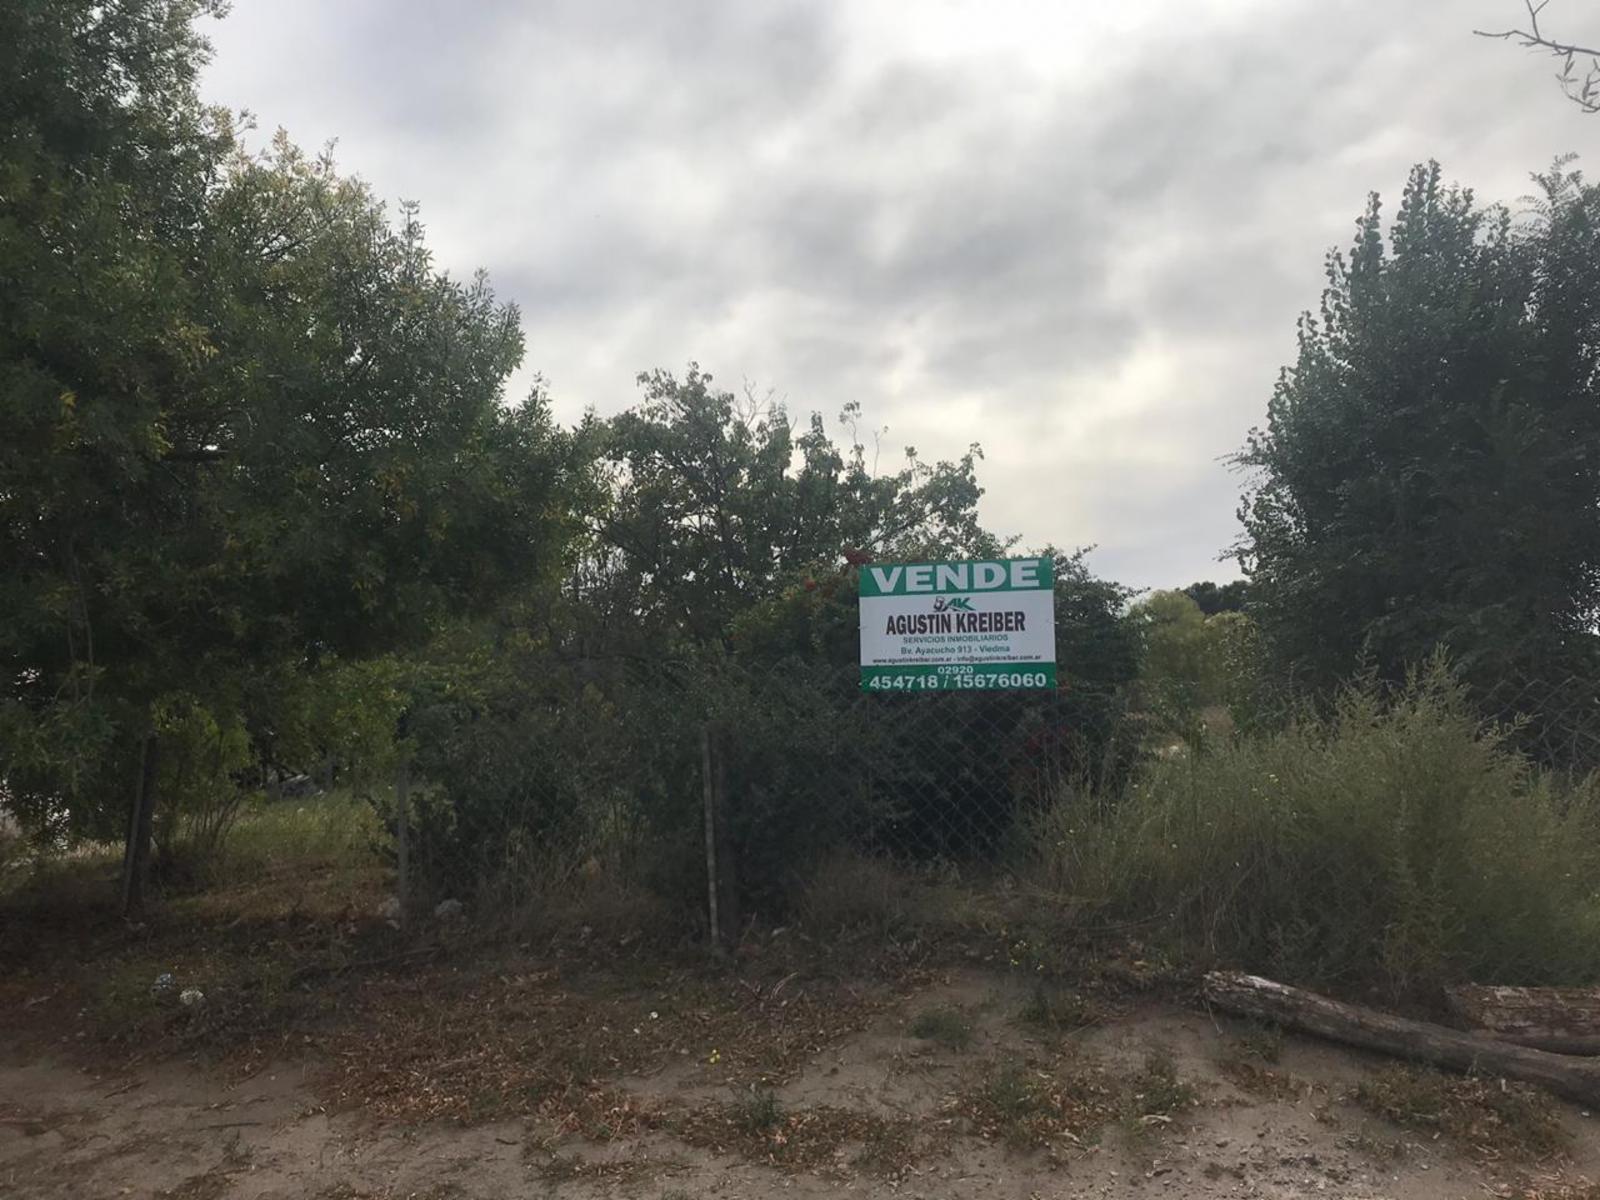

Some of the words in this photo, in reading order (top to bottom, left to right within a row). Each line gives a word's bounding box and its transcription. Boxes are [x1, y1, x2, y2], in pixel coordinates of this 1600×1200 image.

[871, 561, 1040, 593] VENDE
[886, 613, 951, 635] AGUSTIN
[956, 611, 1026, 633] KREIBER
[903, 635, 946, 644] SERVICIOS
[947, 634, 1009, 642] INMOBILIARIOS
[901, 647, 913, 655] Bv.
[916, 646, 955, 655] Ayacucho
[980, 645, 1010, 653] Viedma
[937, 666, 974, 675] 02920
[869, 675, 938, 689] 454718
[953, 673, 1047, 688] 15676060
